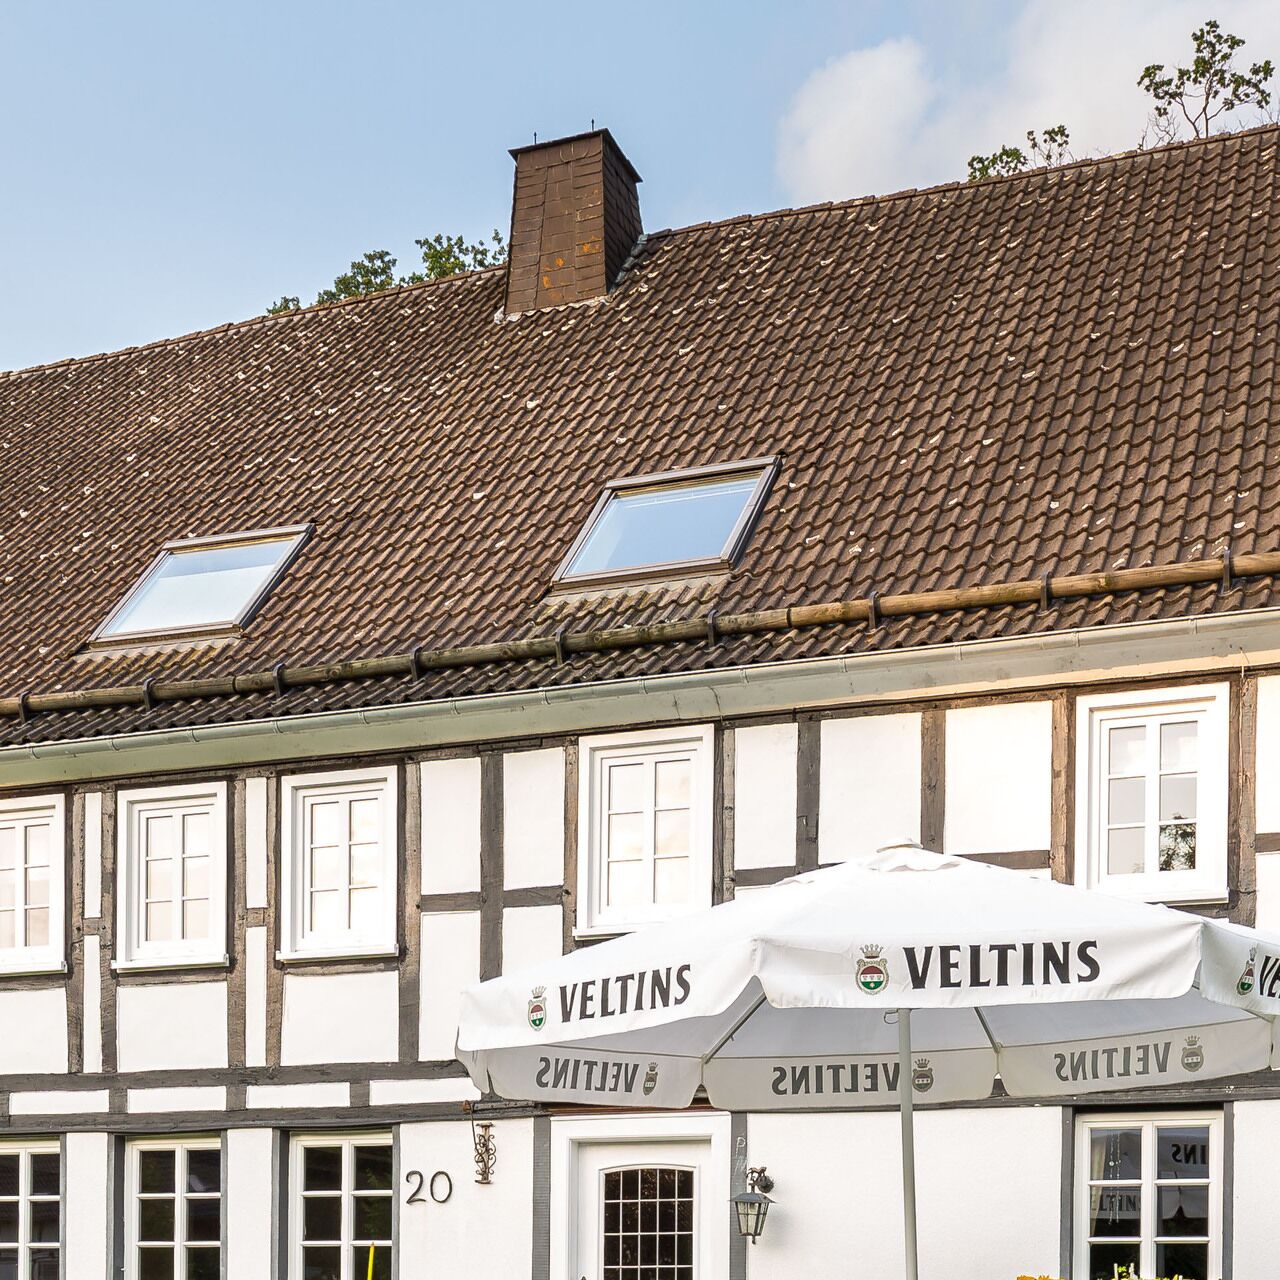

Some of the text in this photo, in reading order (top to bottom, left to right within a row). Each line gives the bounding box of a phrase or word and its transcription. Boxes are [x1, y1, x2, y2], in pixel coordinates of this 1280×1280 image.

[903, 940, 1100, 990] VELTINS
[559, 964, 691, 1023] VELTINS
[406, 1170, 453, 1205] 20
